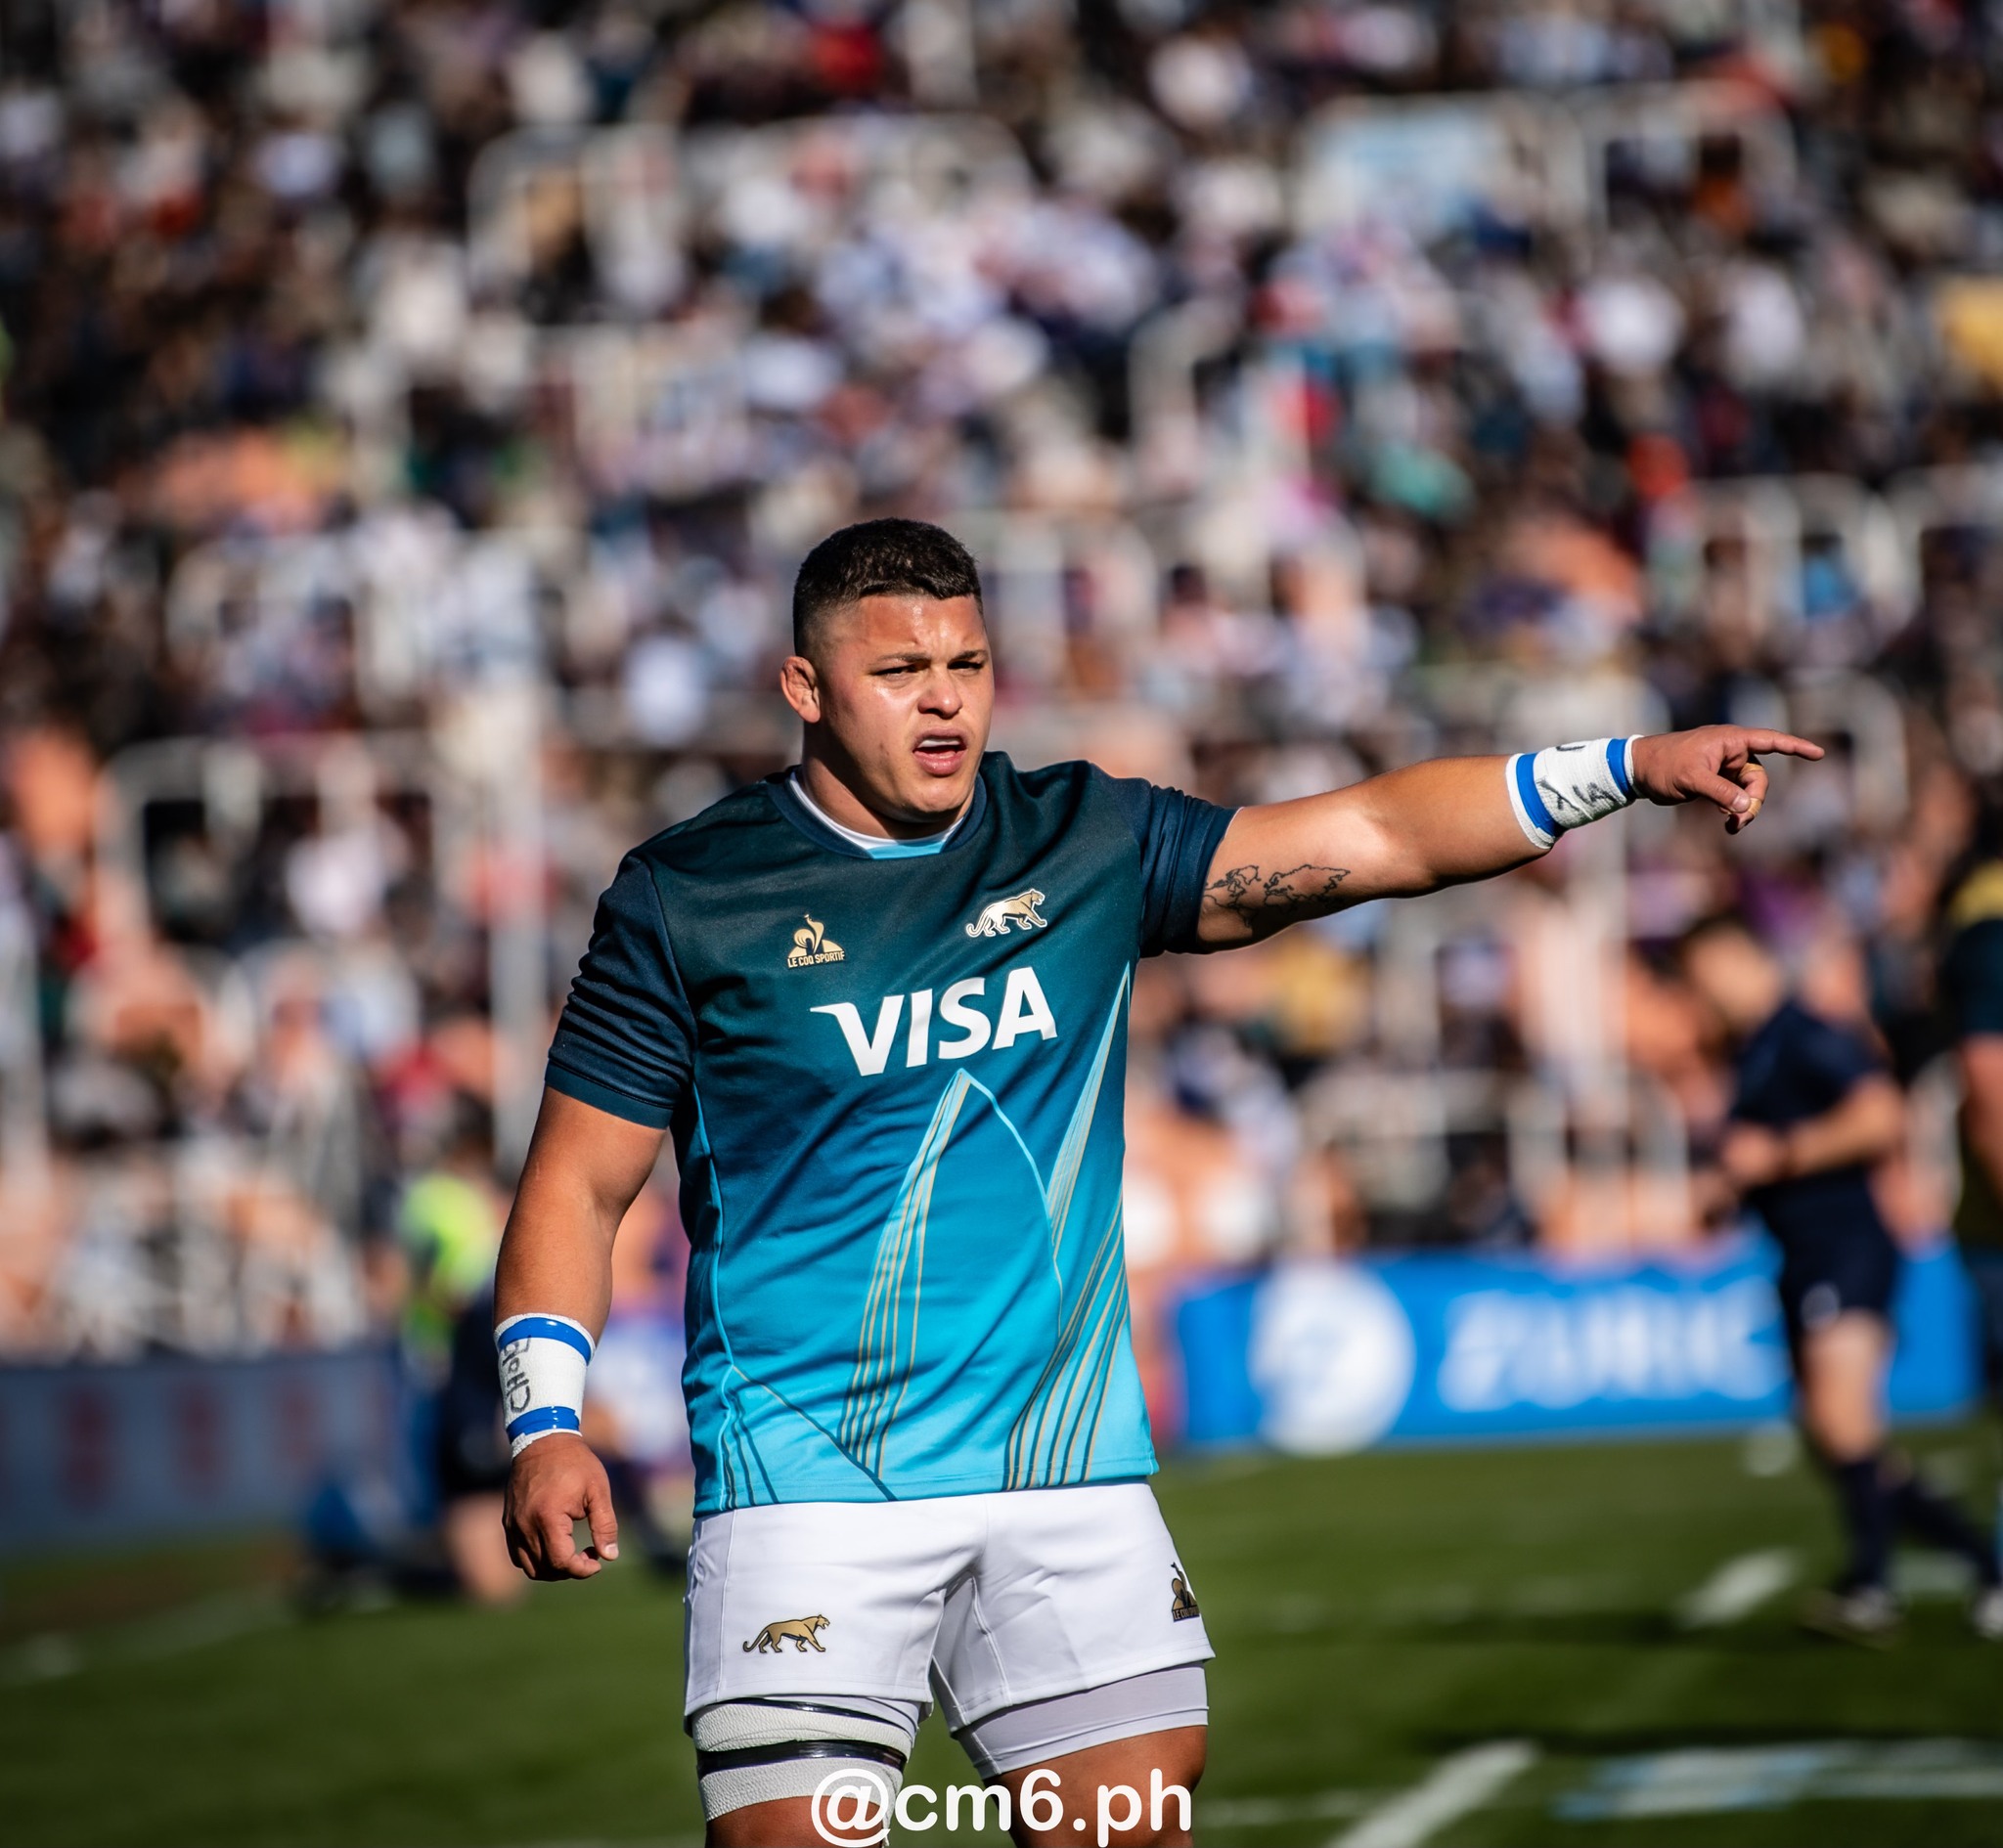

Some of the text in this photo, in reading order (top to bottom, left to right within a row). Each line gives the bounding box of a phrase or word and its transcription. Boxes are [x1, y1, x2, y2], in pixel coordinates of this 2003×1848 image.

[787, 950, 845, 968] LE COQ SPORTIF
[810, 966, 1058, 1077] VISA
[1438, 1277, 1792, 1410] ZURIC
